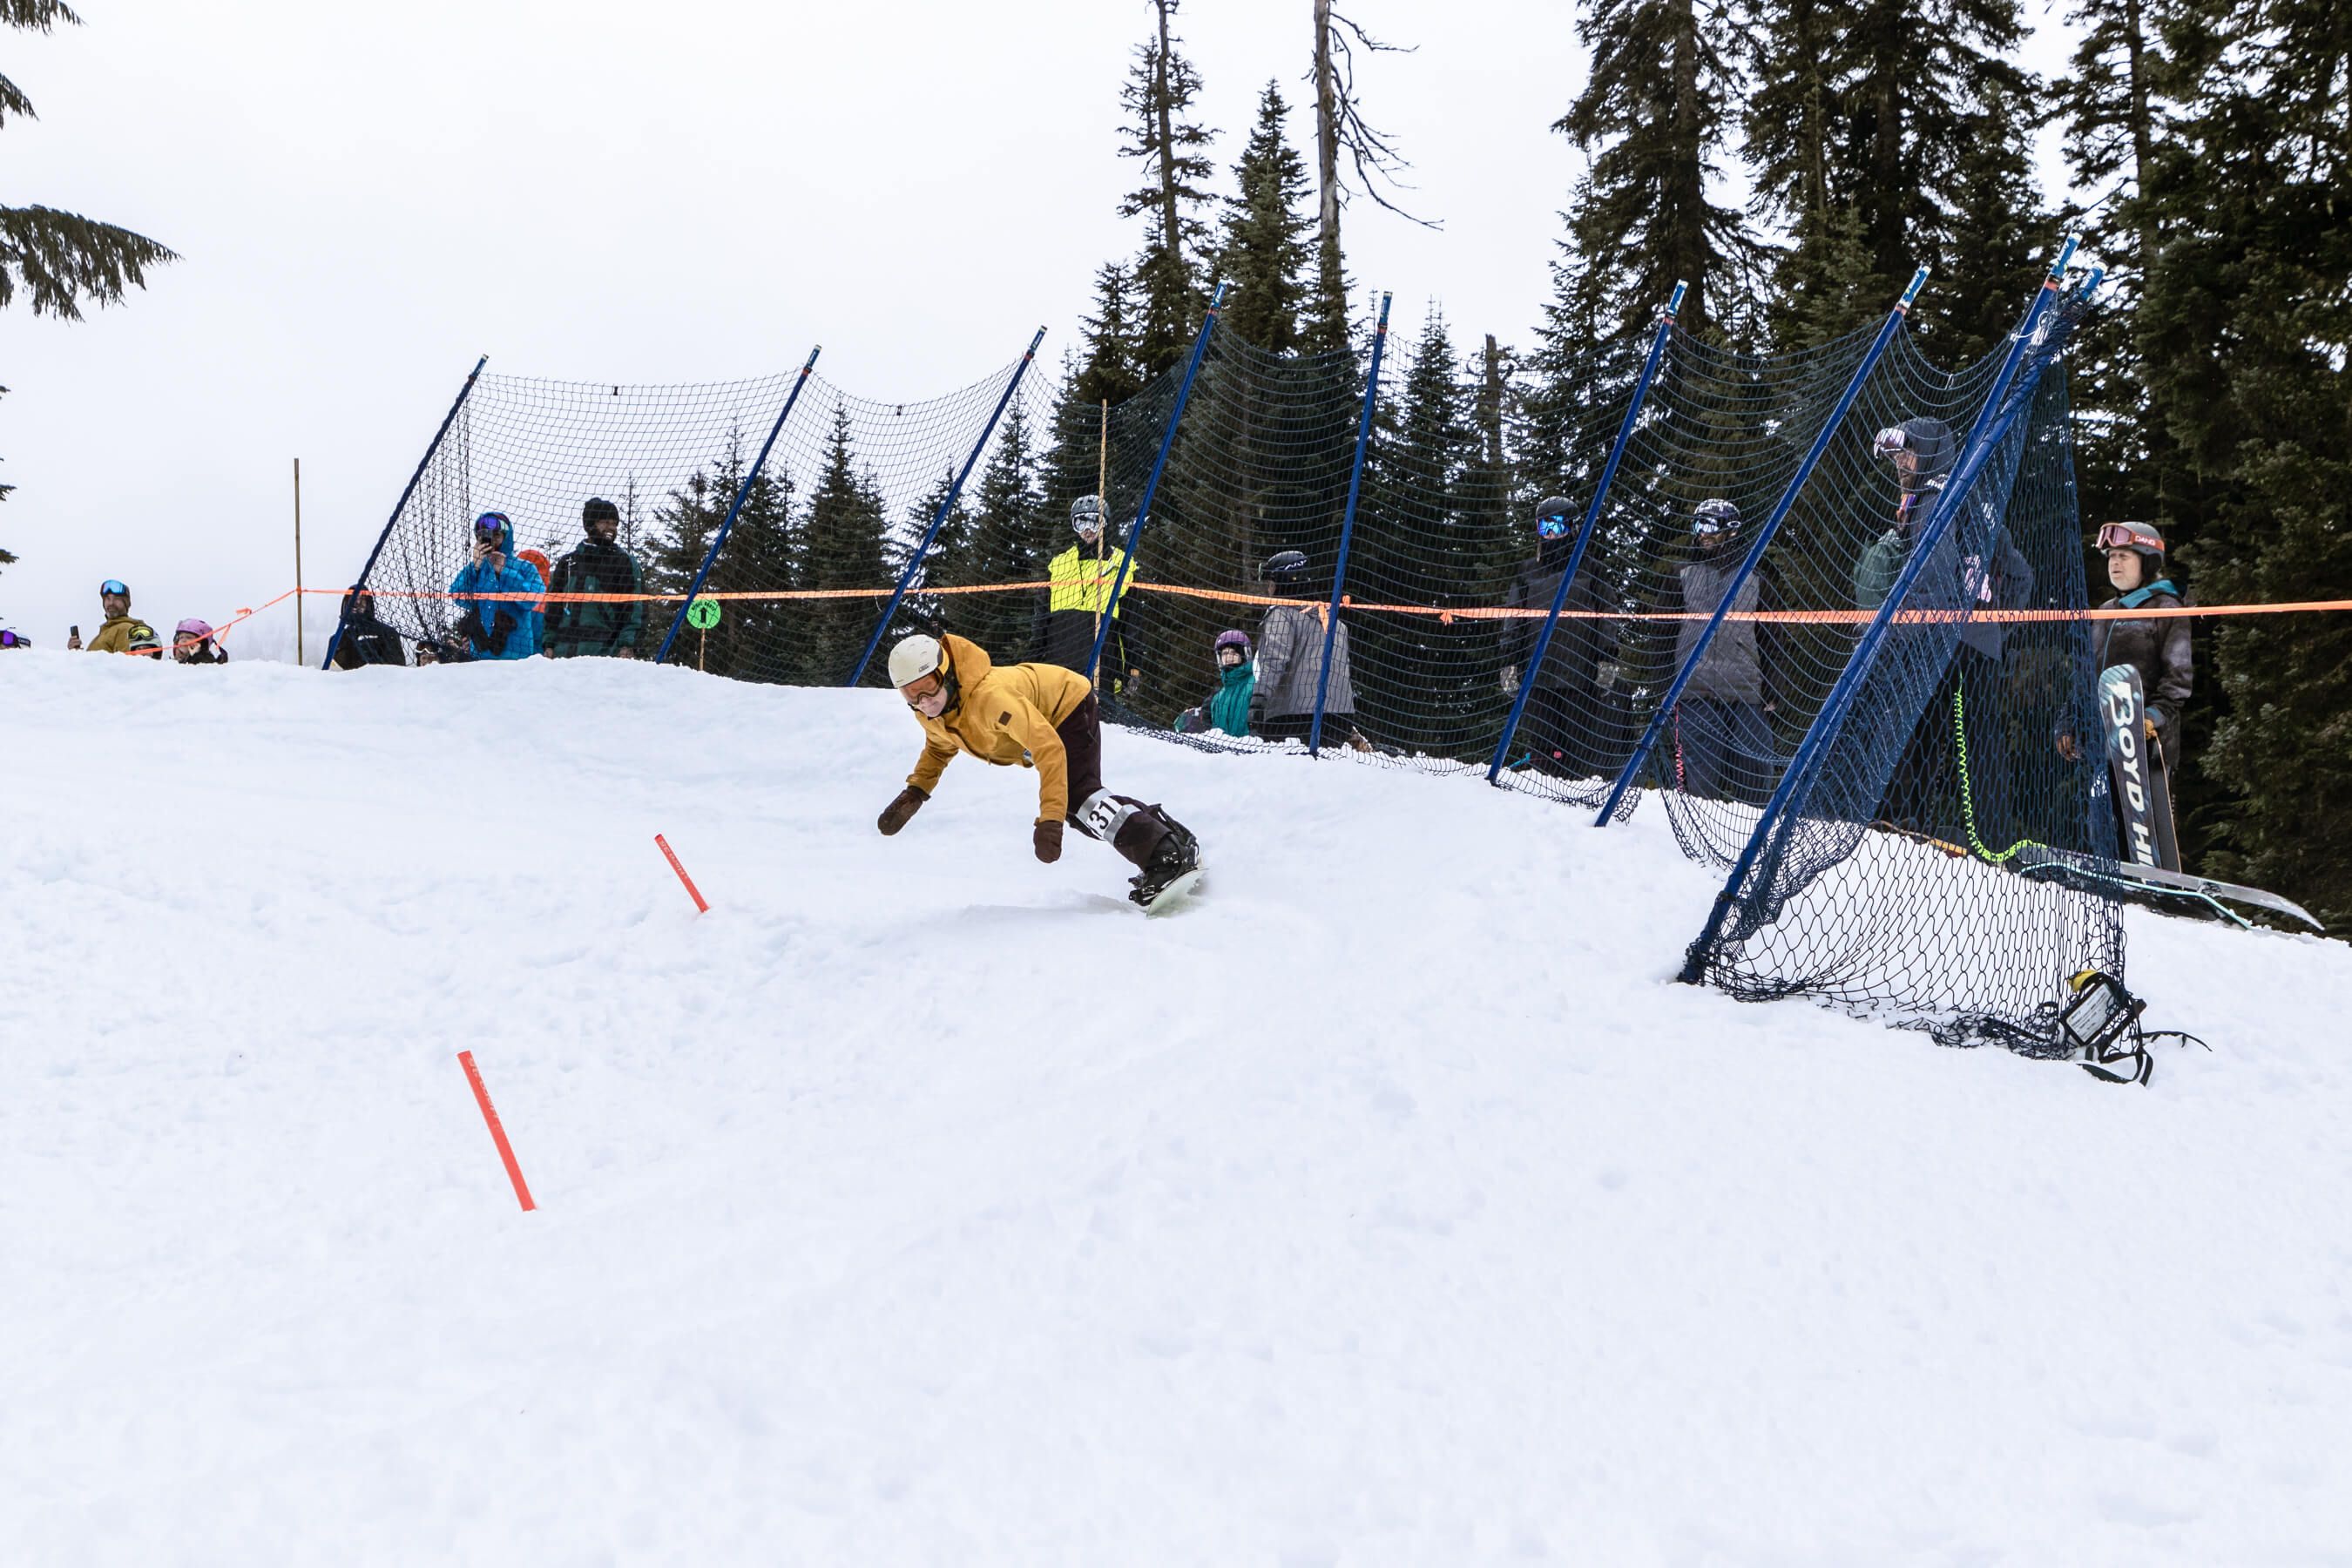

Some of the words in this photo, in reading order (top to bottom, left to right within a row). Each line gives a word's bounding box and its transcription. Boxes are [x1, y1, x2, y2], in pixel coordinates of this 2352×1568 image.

[1089, 800, 1117, 830] 31
[2105, 681, 2145, 812] BOYD
[2132, 821, 2155, 885] HI
